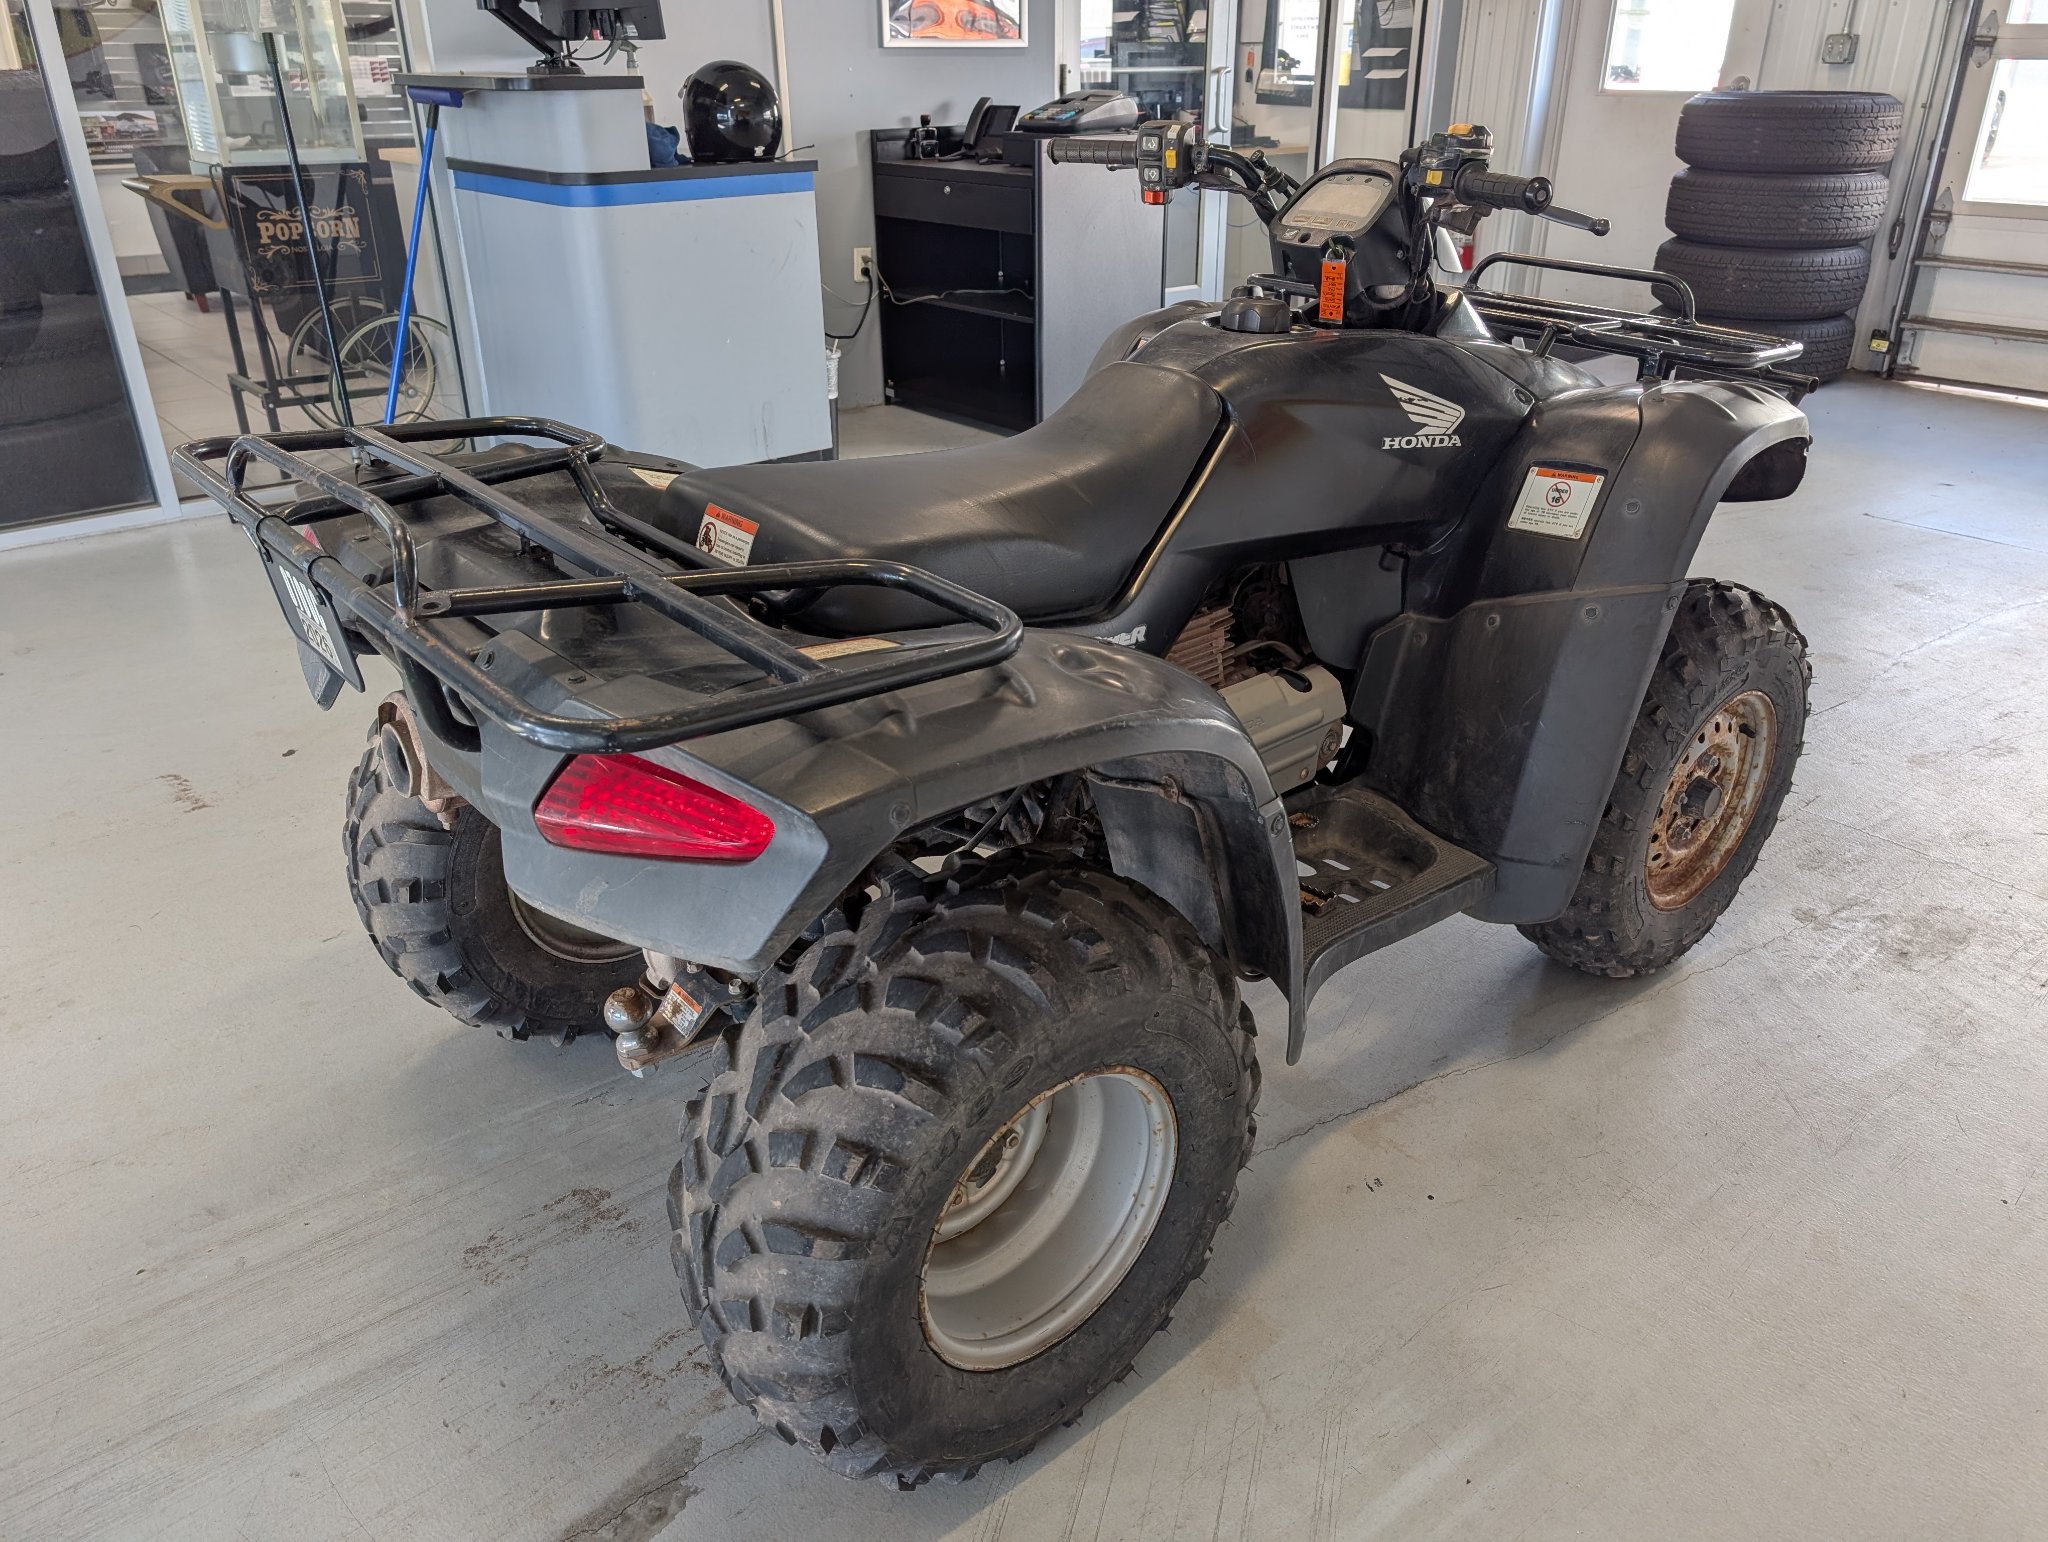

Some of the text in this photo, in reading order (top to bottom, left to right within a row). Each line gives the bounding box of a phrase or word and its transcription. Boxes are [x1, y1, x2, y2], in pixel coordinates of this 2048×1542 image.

[1382, 435, 1462, 450] HONDA
[1551, 496, 1561, 504] 16
[720, 512, 744, 528] WARNING
